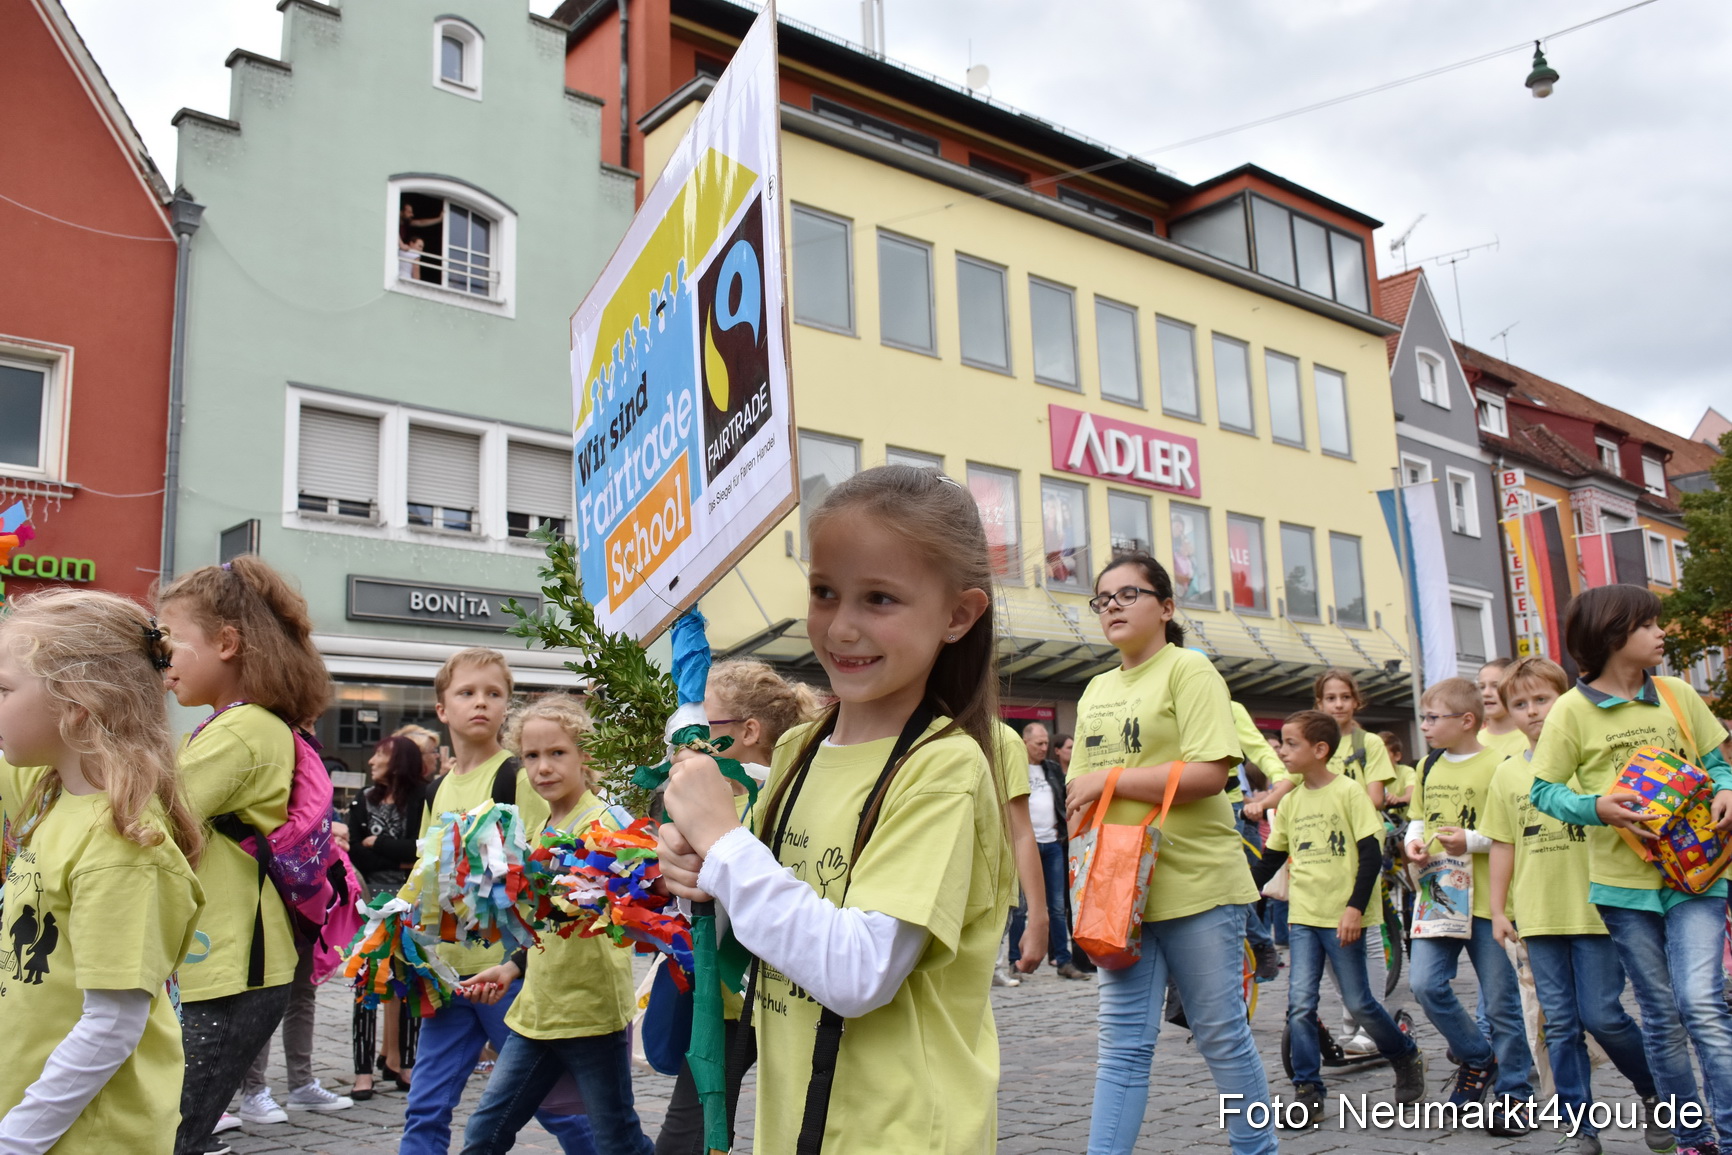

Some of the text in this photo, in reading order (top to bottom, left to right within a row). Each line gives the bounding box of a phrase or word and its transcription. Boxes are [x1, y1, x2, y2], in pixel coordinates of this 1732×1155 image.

[577, 371, 648, 487] Wir sind
[580, 388, 692, 552] Fairtrade
[707, 382, 768, 471] FAIRTRADE
[716, 480, 732, 504] Siegel
[740, 457, 756, 480] Fairen
[756, 433, 775, 463] Handel
[1068, 412, 1195, 490] ADLER
[612, 473, 685, 597] School
[1605, 726, 1657, 742] Grundschule
